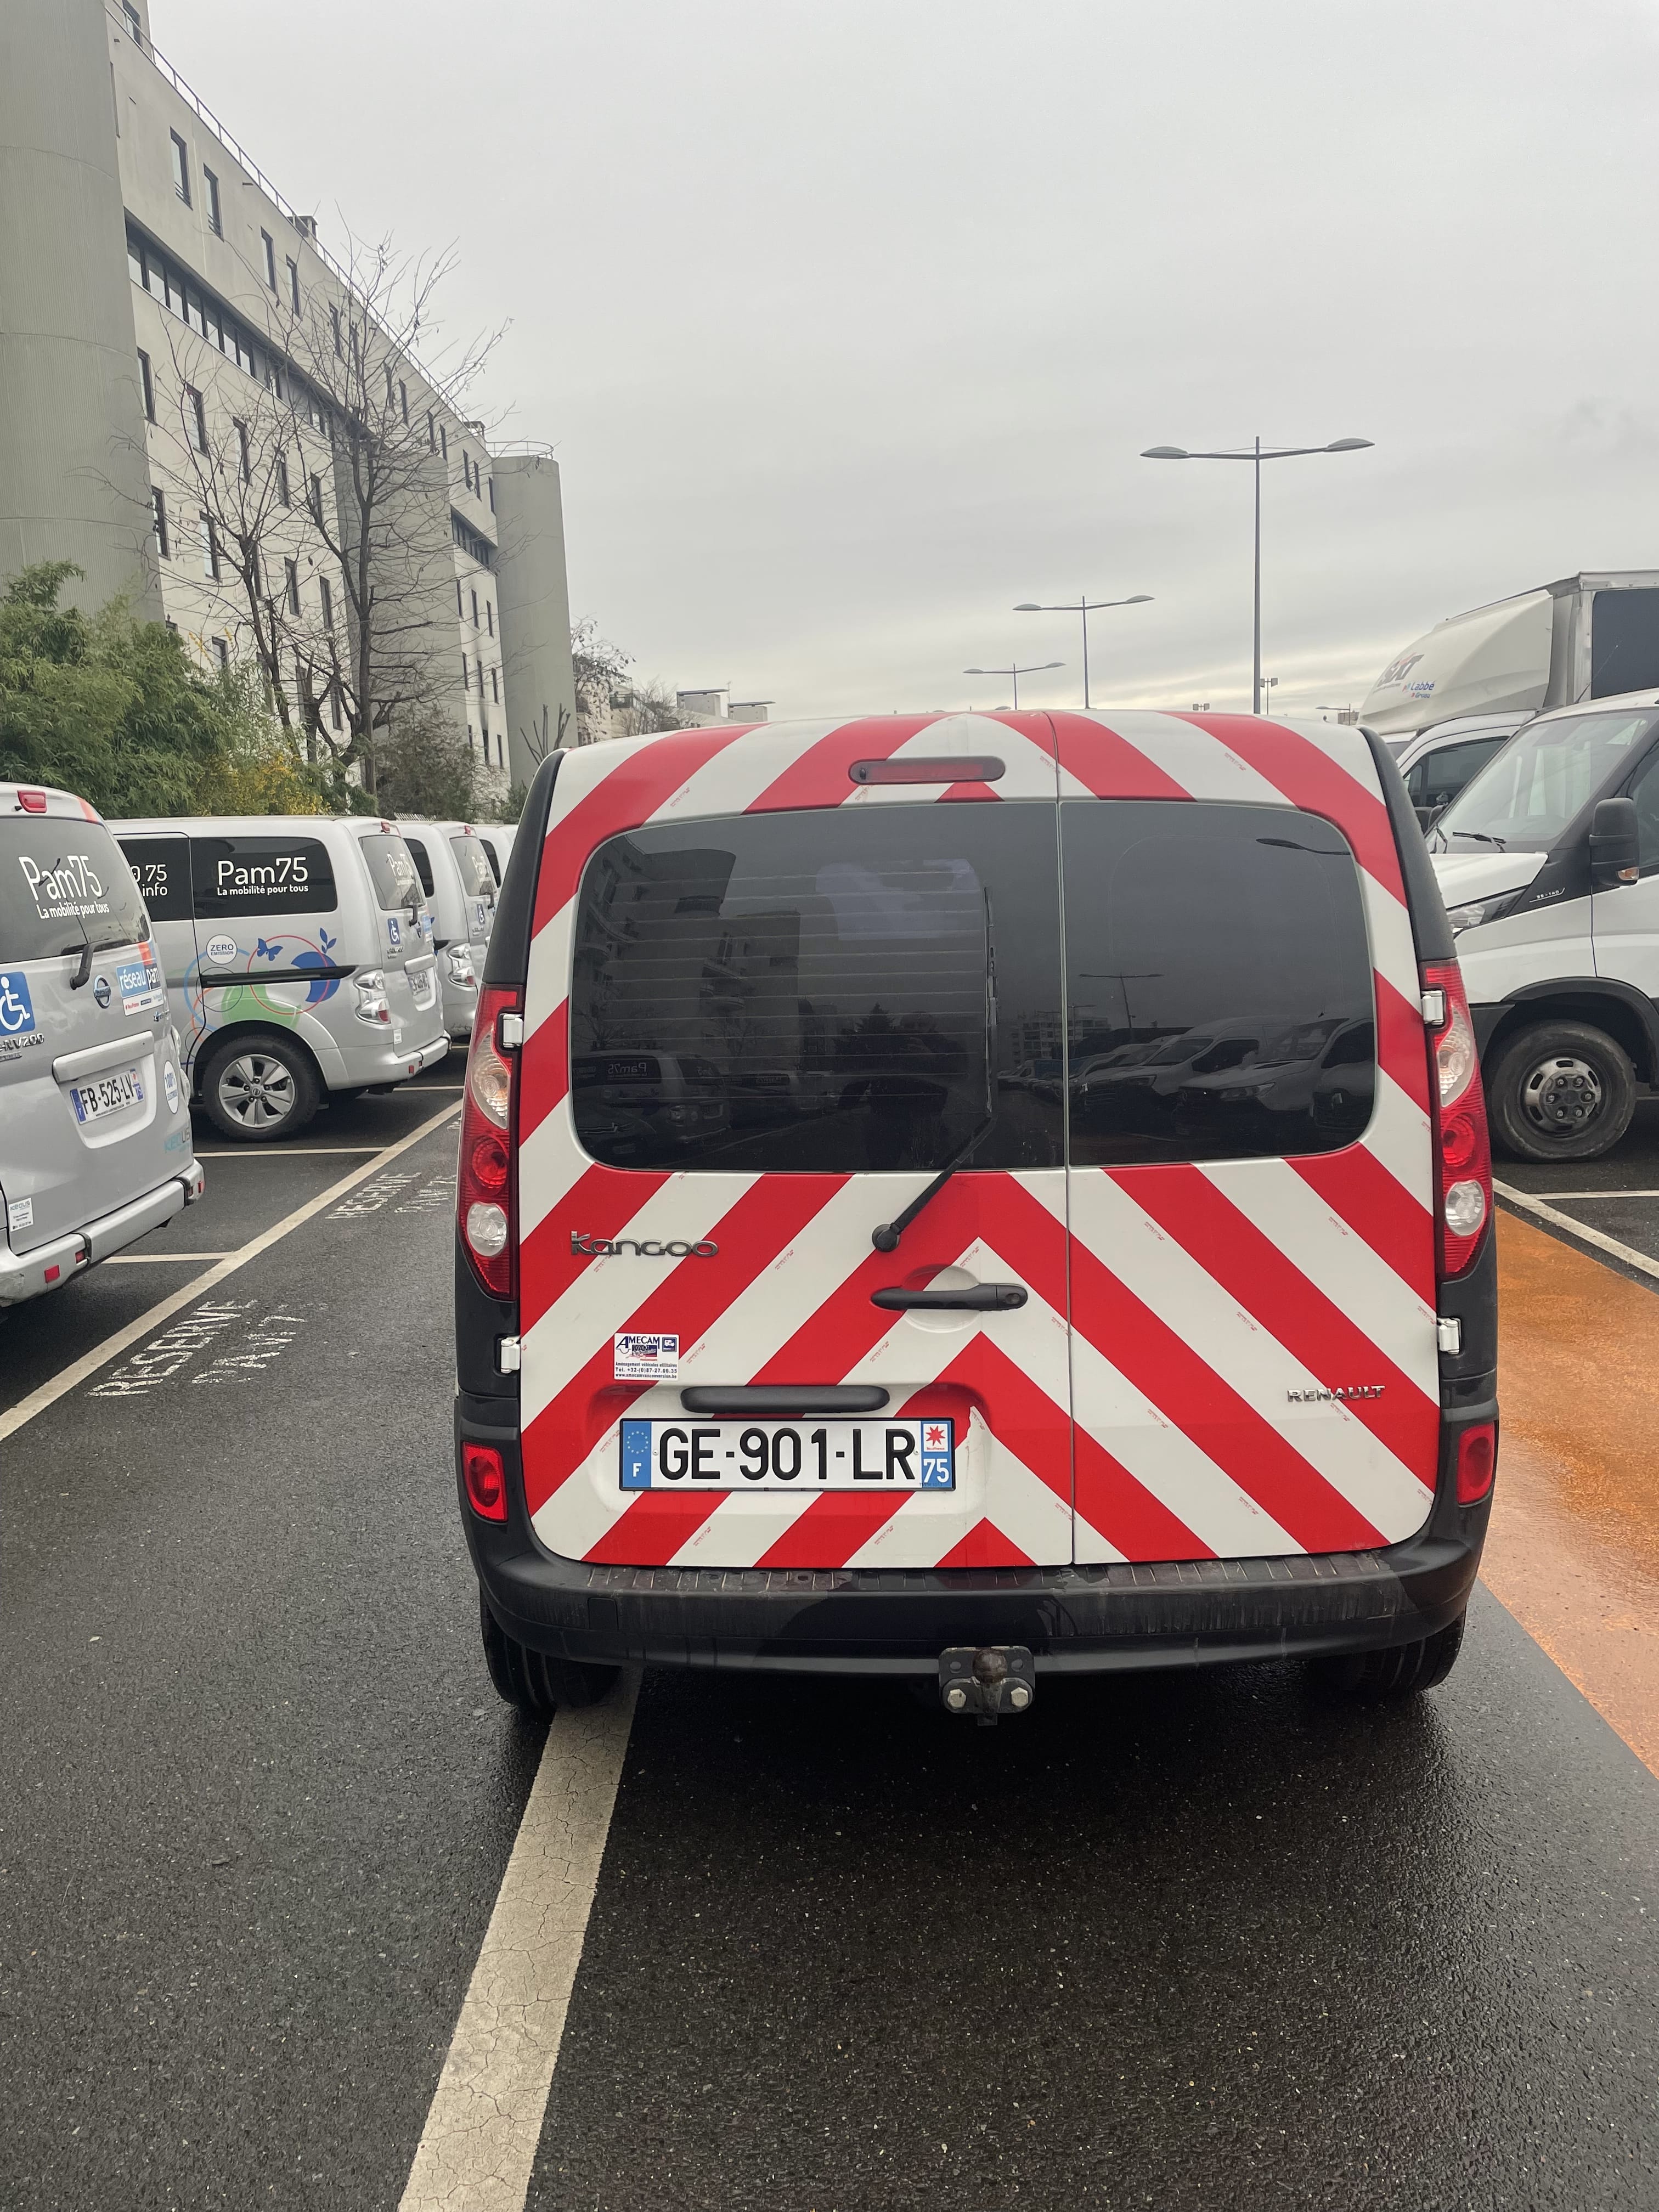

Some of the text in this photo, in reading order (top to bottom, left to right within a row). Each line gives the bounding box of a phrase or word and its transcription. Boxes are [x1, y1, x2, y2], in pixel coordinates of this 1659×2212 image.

[1411, 681, 1435, 690] Labbé
[18, 855, 103, 901] Pam75
[145, 864, 167, 882] 75
[218, 857, 308, 885] Pam75
[142, 882, 167, 896] info
[217, 887, 228, 895] La
[229, 885, 266, 895] mobilité
[267, 886, 287, 895] pour
[36, 901, 110, 919] La mobilité pour tous
[119, 967, 160, 991] réseau pam
[80, 1074, 134, 1115] FB-525-LV
[324, 1172, 422, 1219] RESERVE
[84, 1299, 258, 1397] RESERVE
[616, 1336, 660, 1349] AMECAM
[1288, 1385, 1385, 1402] RENAULT
[659, 1427, 916, 1480] GE-901-LR
[633, 1463, 642, 1477] F
[923, 1458, 949, 1483] 75
